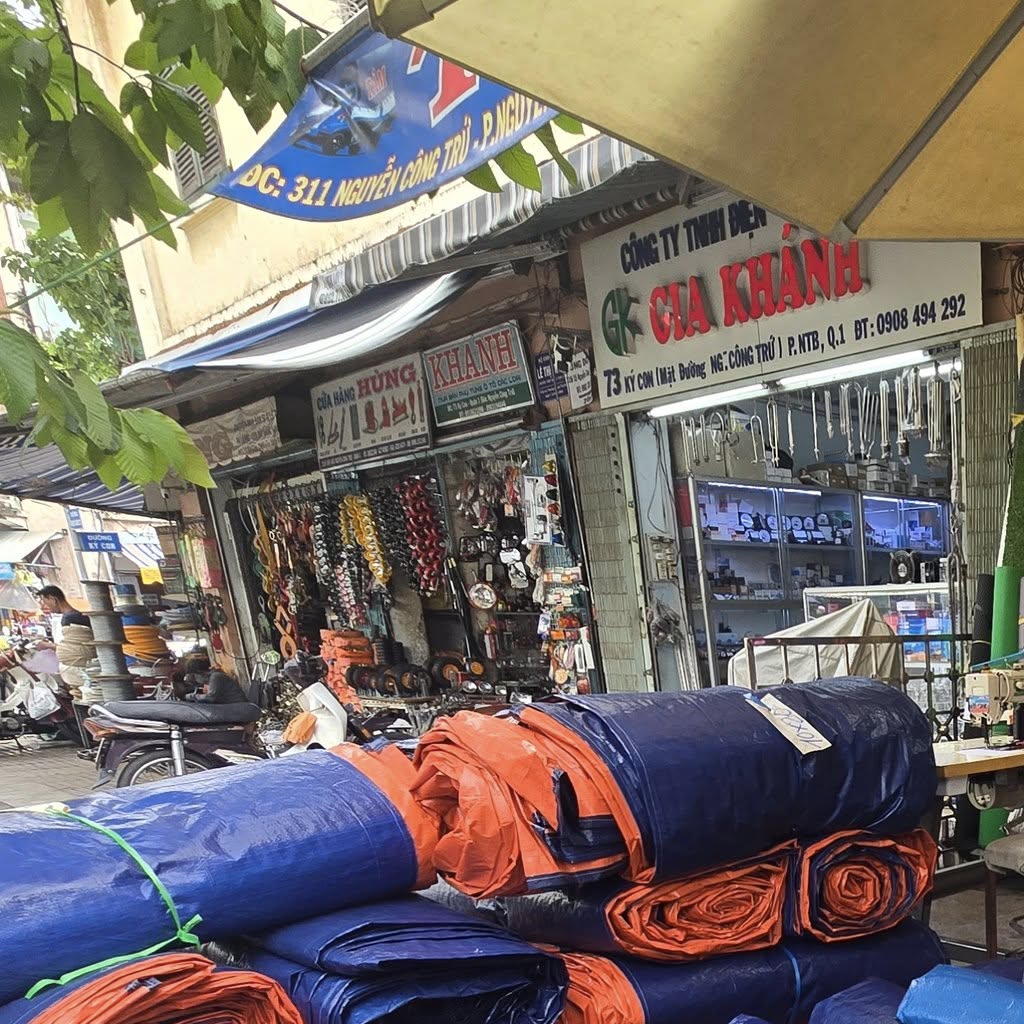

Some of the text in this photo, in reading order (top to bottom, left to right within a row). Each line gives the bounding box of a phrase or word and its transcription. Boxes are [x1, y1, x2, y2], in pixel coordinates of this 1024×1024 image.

[287, 176, 333, 206] 311
[331, 155, 403, 207] NGUYỄN
[400, 147, 442, 192] CÔNG
[440, 113, 471, 174] TRỨ
[620, 232, 660, 274] CÔNG
[659, 224, 680, 260] TY
[683, 207, 726, 252] TNHH
[649, 223, 863, 345] GIA KHÁNH
[427, 328, 519, 392] KHANH
[604, 367, 621, 398] 73
[624, 369, 636, 394] KÝ
[637, 370, 654, 390] CON
[678, 360, 706, 380] Đường
[827, 323, 846, 349] Q.1
[912, 301, 936, 327] 494
[941, 294, 966, 321] 292
[333, 386, 355, 406] HÀNG
[356, 361, 416, 400] HÙNG
